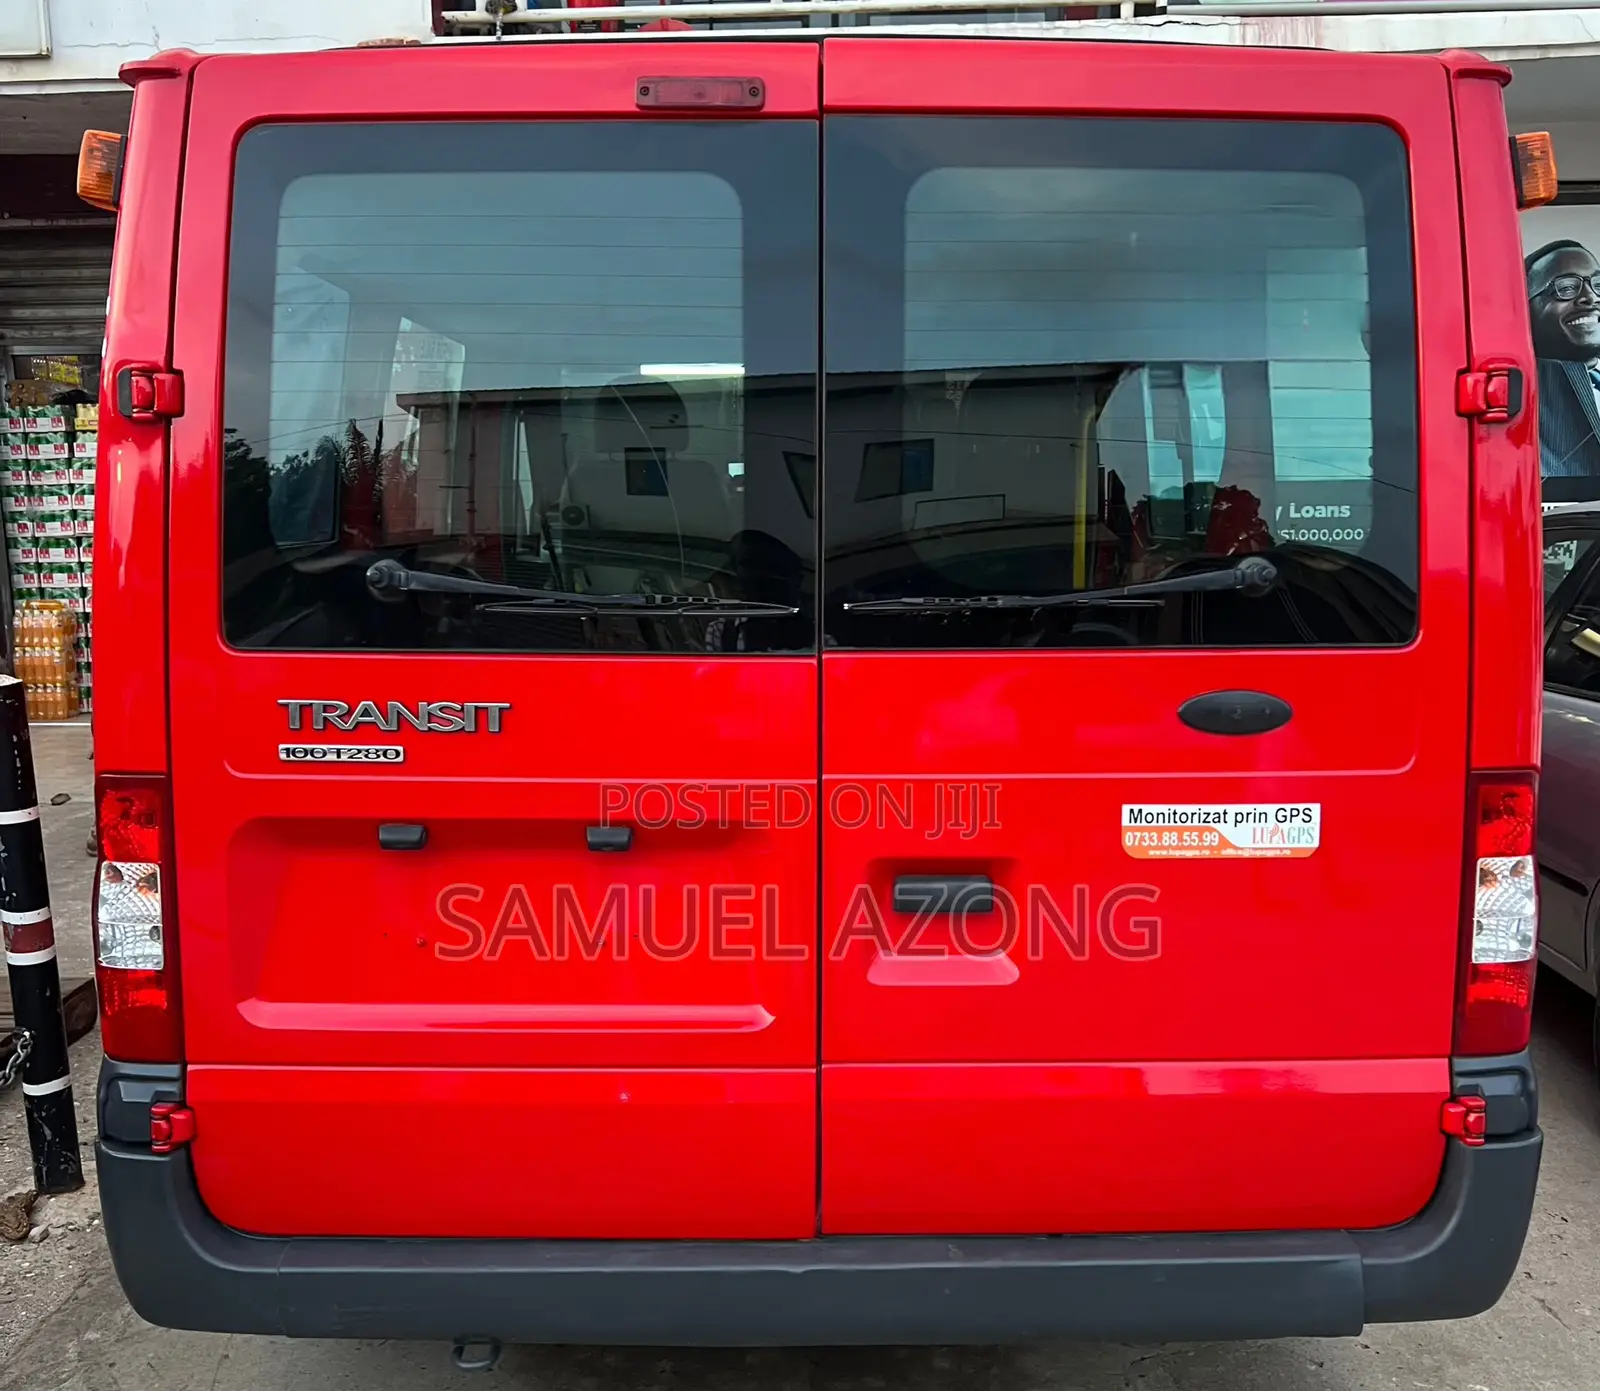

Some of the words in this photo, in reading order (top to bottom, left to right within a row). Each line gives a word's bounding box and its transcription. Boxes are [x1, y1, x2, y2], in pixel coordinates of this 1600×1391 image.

[1289, 503, 1351, 518] Loans
[277, 699, 511, 732] TRANSIT
[280, 746, 401, 760] 100T280
[1128, 807, 1229, 824] Monitorizat
[1234, 808, 1268, 827] prin
[1274, 807, 1313, 824] GPS
[1125, 831, 1220, 847] 0733.88.55.99
